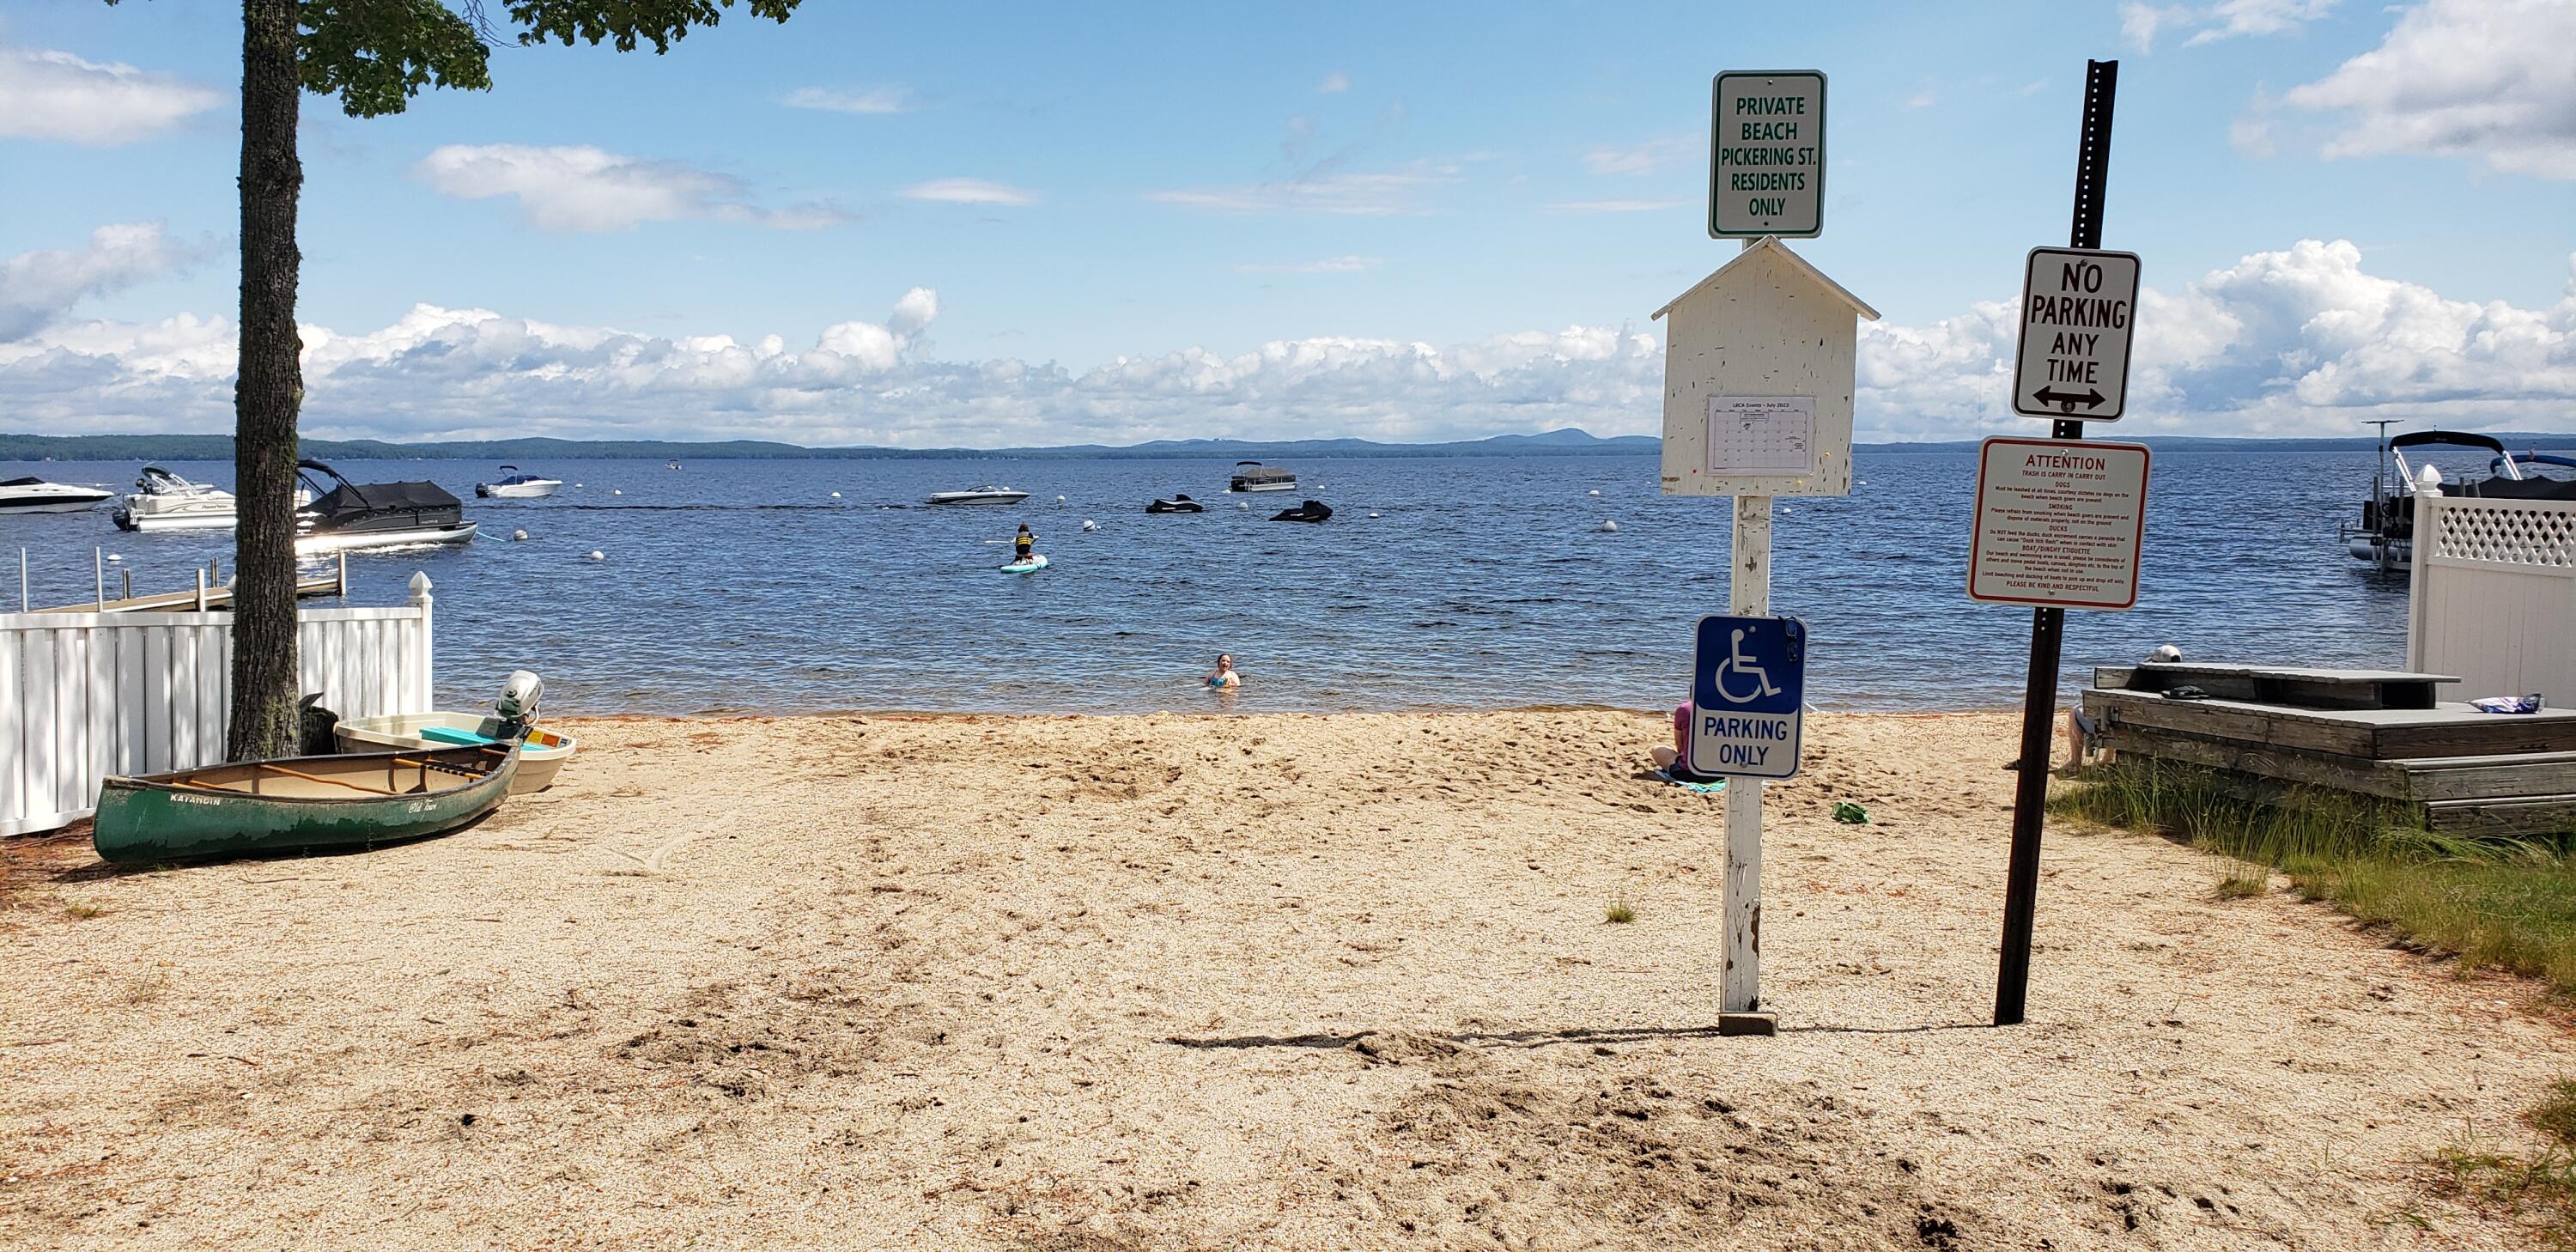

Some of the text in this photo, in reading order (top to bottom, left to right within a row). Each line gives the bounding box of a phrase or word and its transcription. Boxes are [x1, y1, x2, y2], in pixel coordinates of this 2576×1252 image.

[1736, 97, 1805, 115] PRIVATE
[1741, 123, 1797, 140] BEACH
[1722, 148, 1816, 166] PICKERING ST.
[1731, 173, 1805, 191] RESIDENTS
[1749, 198, 1786, 216] ONLY
[2061, 263, 2103, 293] NO
[2031, 295, 2126, 329] PARKING
[2050, 332, 2099, 356] ANY
[2047, 359, 2099, 384] TIME
[2026, 455, 2105, 471] ATTENTION
[1704, 717, 1787, 740] PARKING
[1720, 745, 1769, 765] ONLY
[170, 793, 221, 805] KATAHDIN
